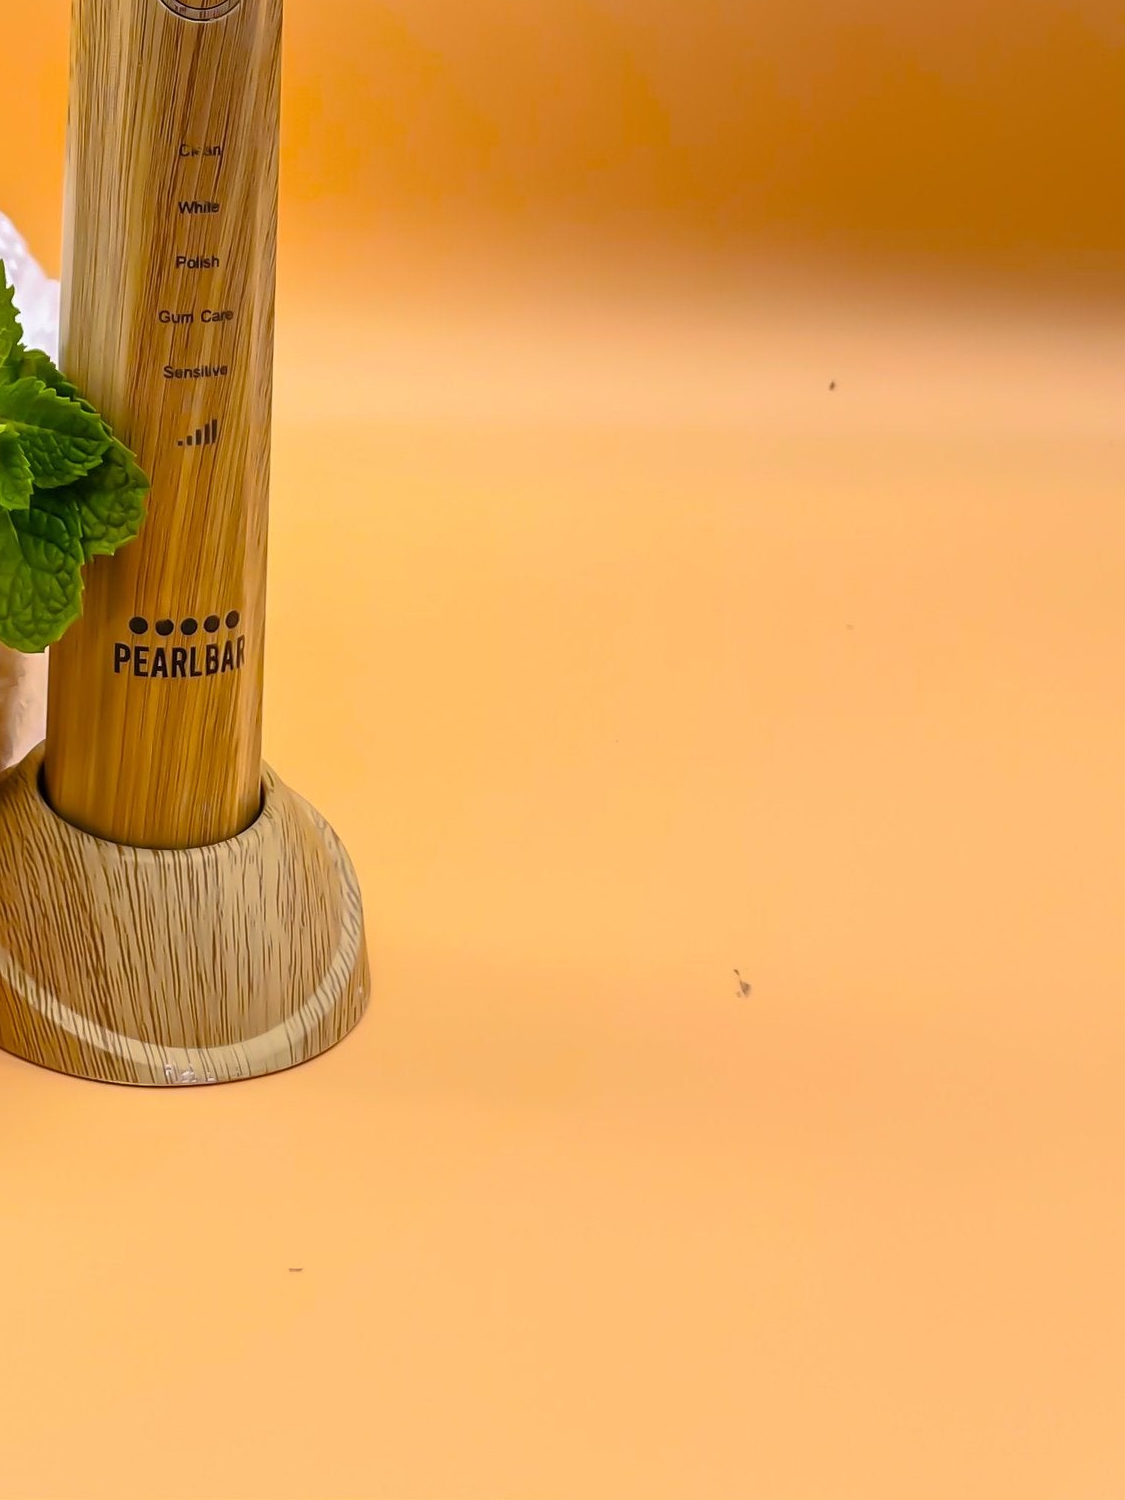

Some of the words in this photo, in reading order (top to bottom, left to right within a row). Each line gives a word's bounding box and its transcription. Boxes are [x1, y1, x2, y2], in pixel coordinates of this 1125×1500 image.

[178, 201, 220, 214] White
[176, 256, 220, 269] Polish
[158, 310, 194, 323] Gum
[200, 309, 234, 322] Care
[163, 364, 228, 379] Sensitive
[113, 635, 246, 678] PEARLBAR
